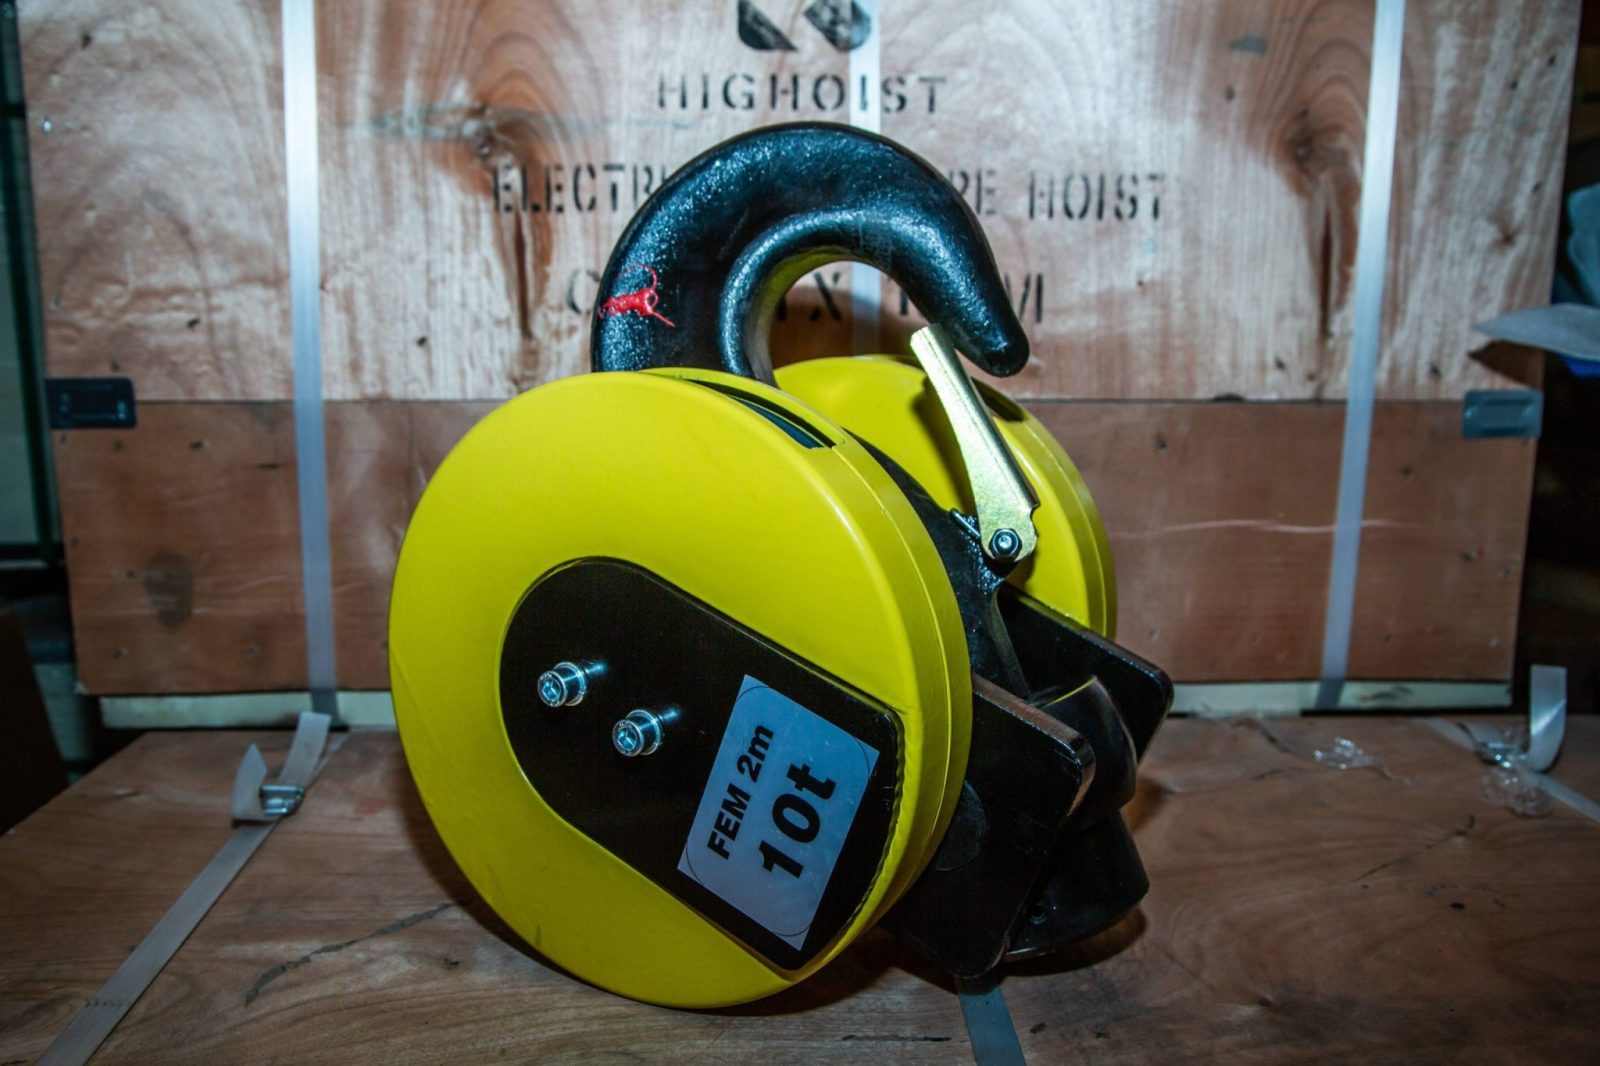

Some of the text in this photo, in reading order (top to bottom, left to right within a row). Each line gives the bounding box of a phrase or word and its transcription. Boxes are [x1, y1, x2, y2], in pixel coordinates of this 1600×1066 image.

[657, 73, 947, 114] HIGHOIST
[1027, 170, 1167, 221] HOIST
[706, 724, 775, 861] FEM 2m
[758, 762, 837, 879] 10t
